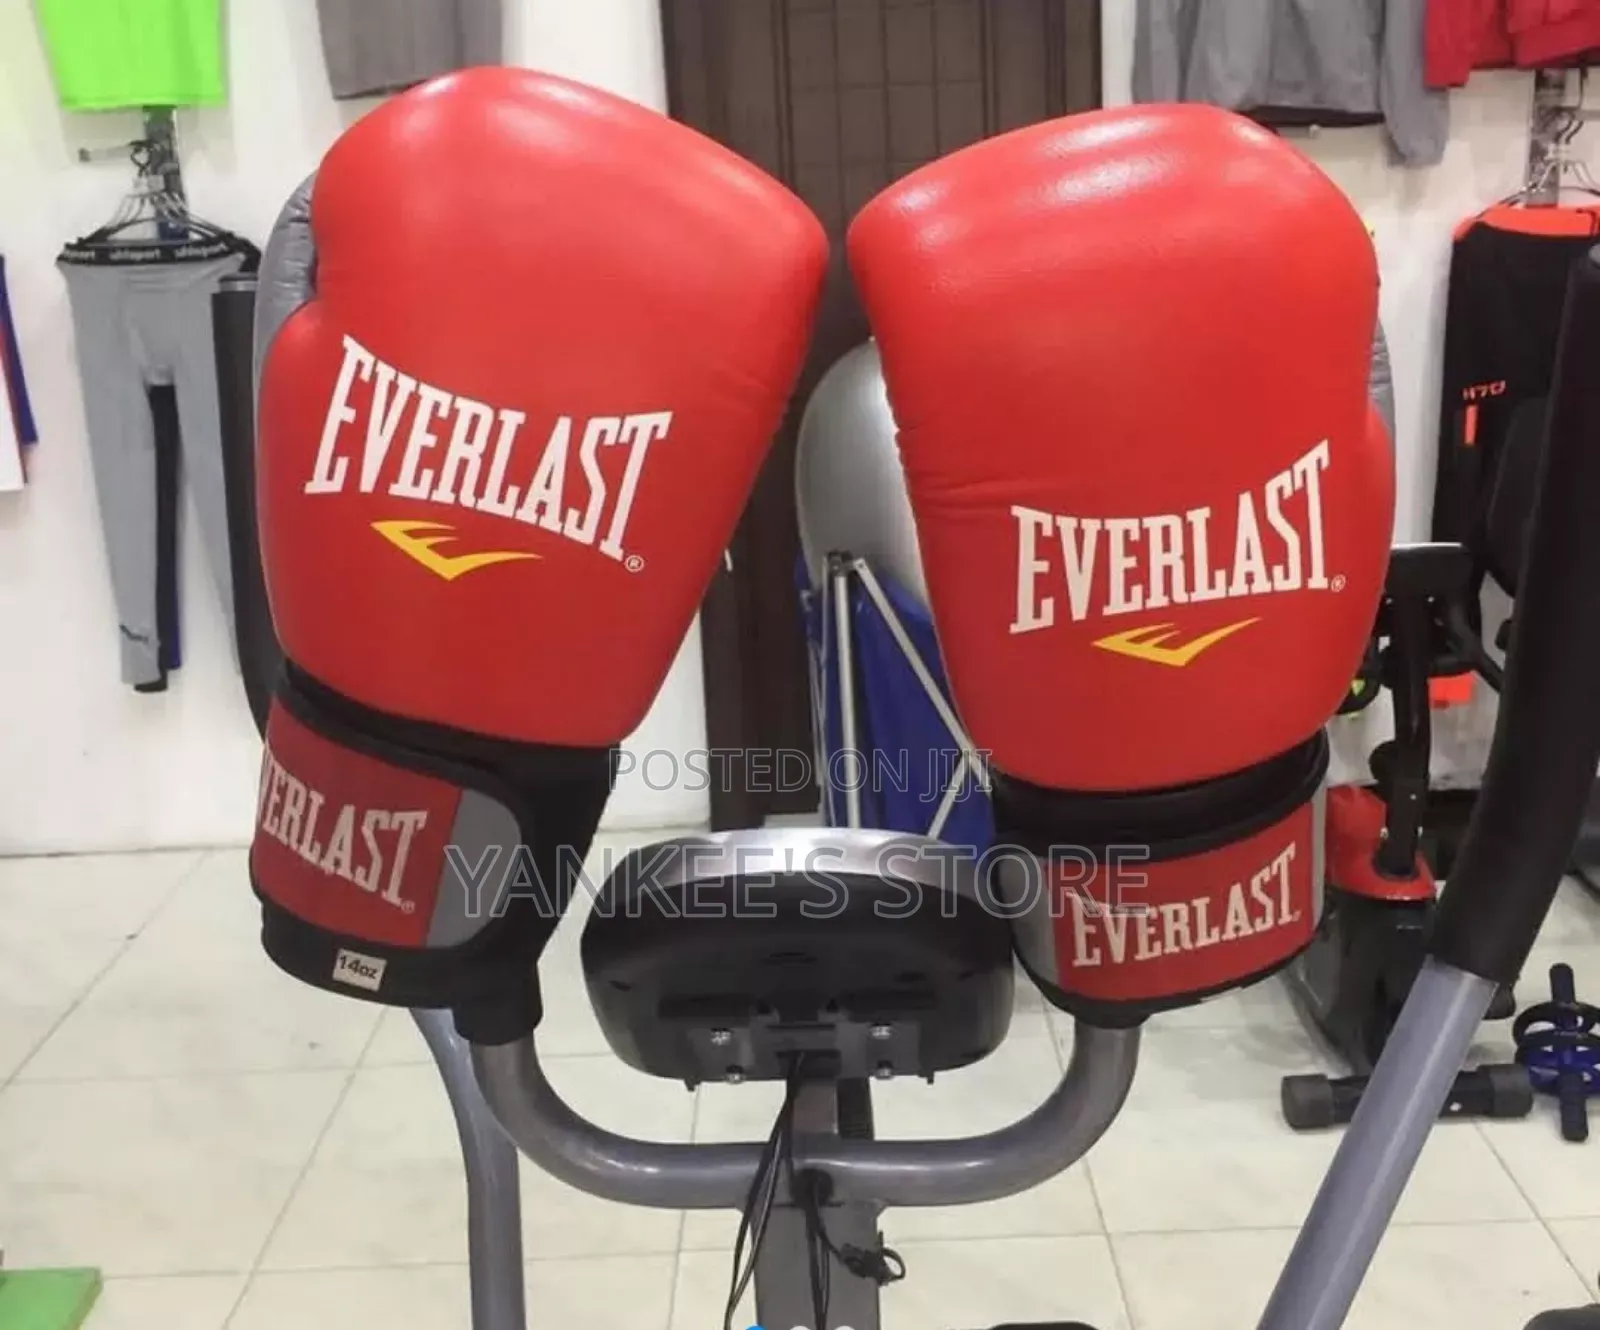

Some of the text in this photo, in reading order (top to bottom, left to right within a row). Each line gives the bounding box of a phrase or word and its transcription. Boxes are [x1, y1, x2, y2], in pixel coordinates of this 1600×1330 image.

[305, 334, 673, 562] EVERLAST
[1009, 438, 1329, 635] EVERLAST
[256, 742, 428, 907] VERLAST
[1066, 841, 1296, 967] EVERLAST
[338, 954, 379, 980] 14oz
